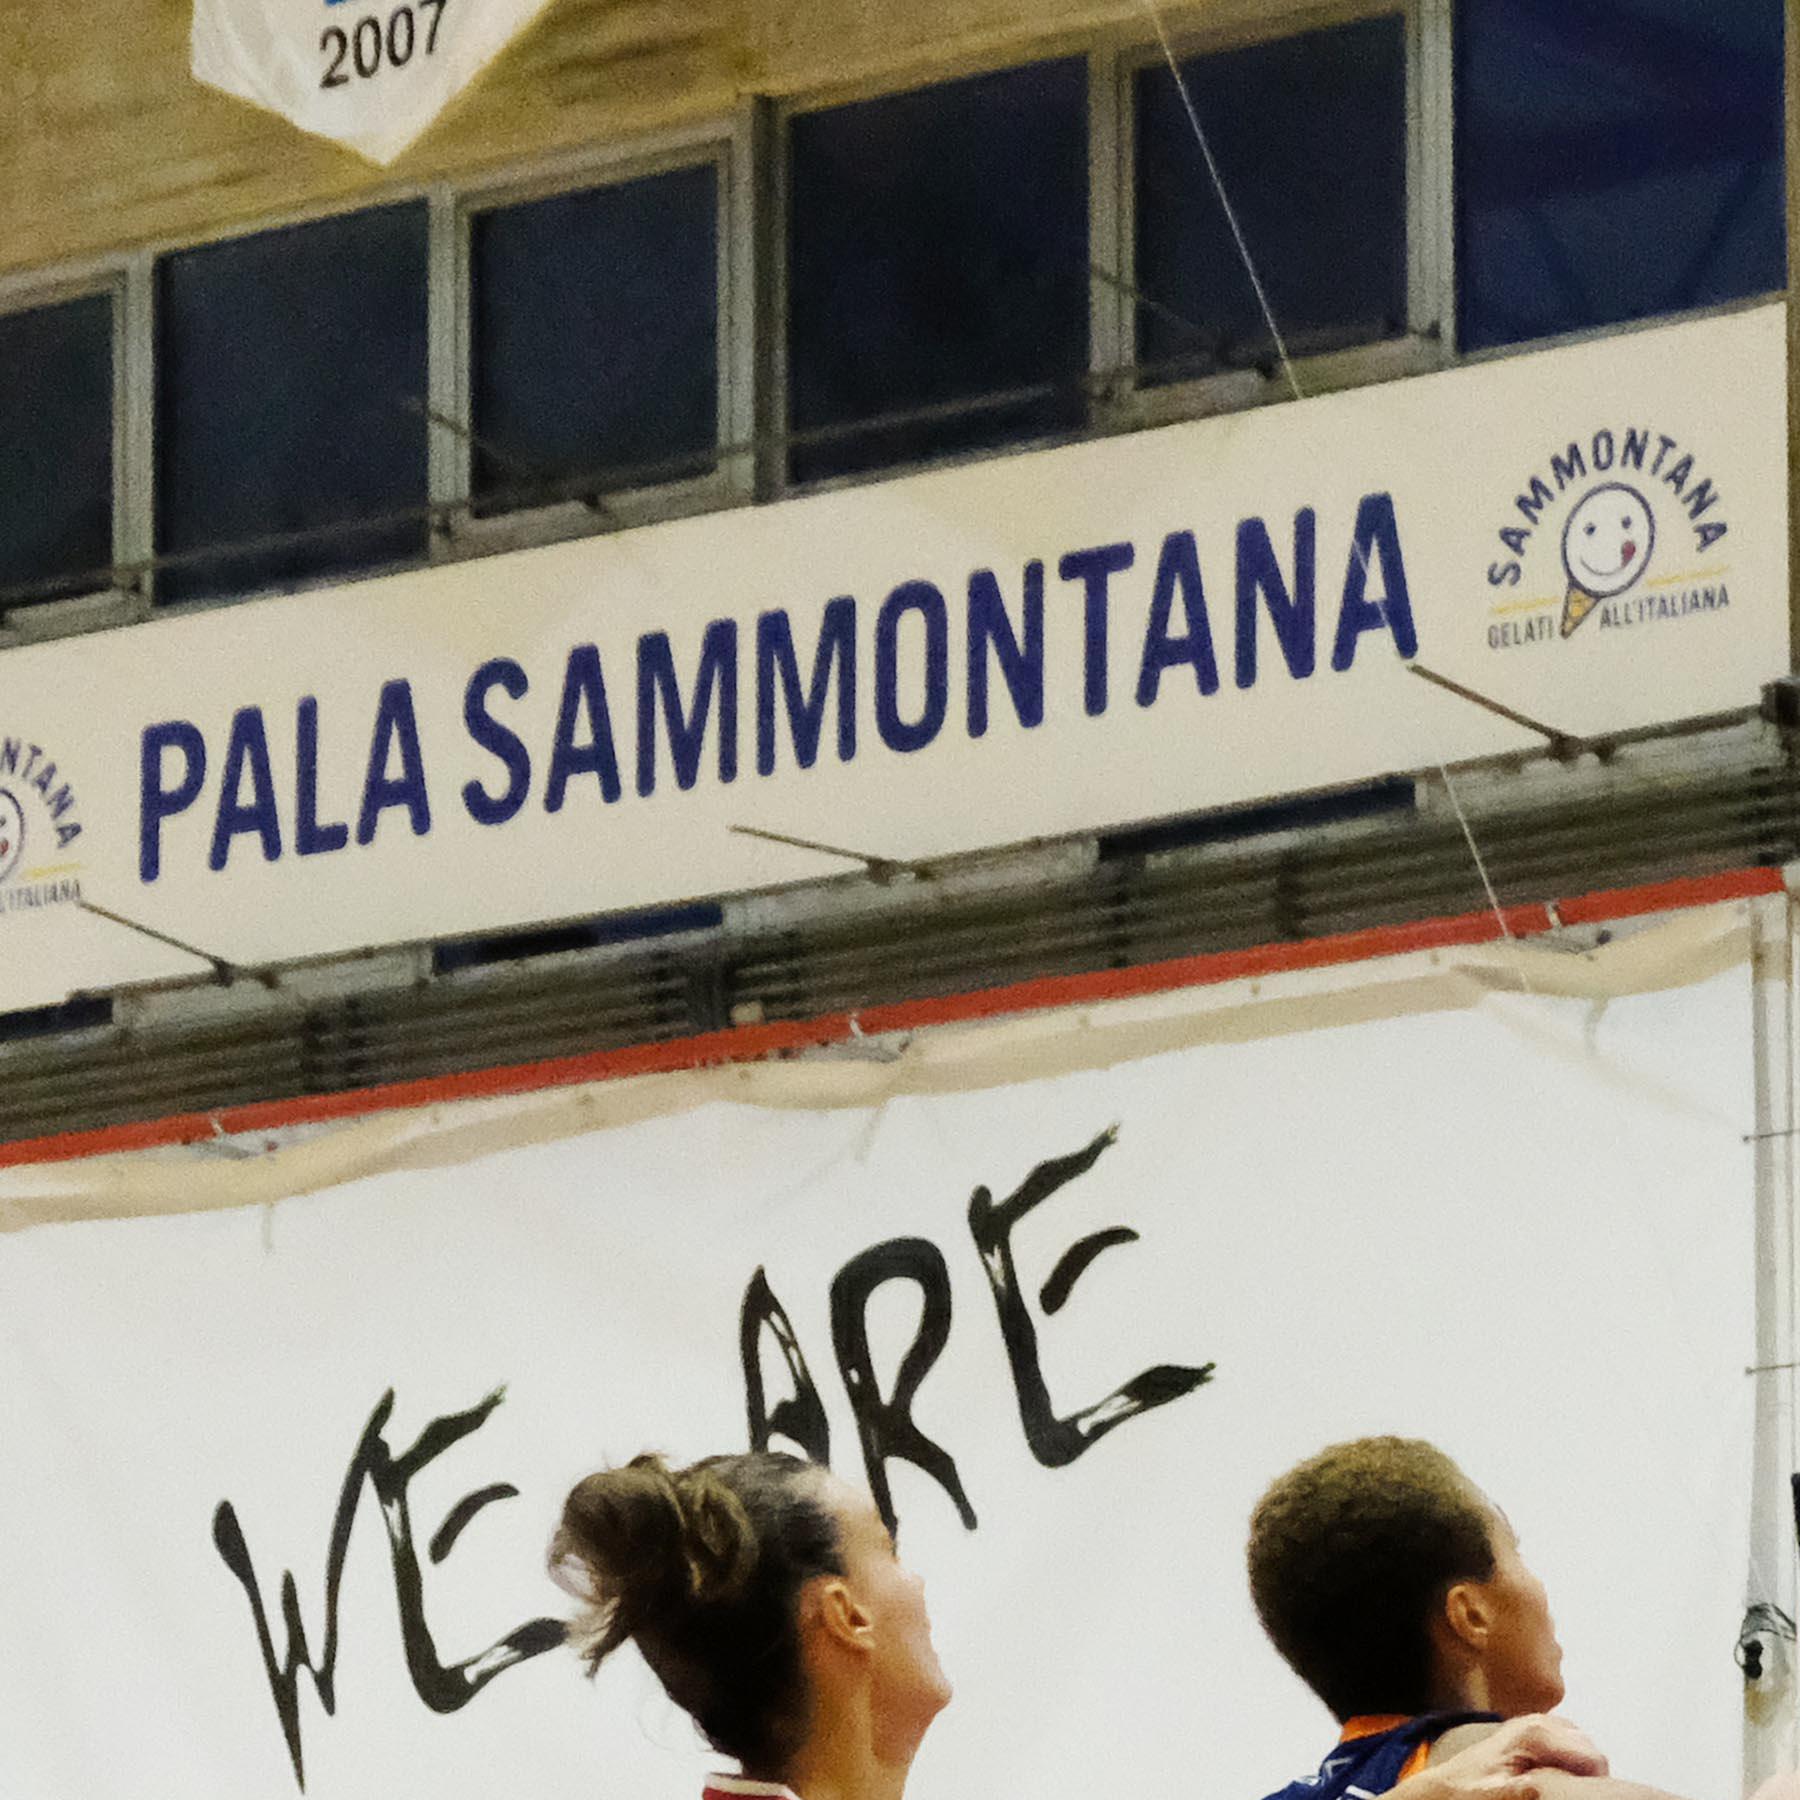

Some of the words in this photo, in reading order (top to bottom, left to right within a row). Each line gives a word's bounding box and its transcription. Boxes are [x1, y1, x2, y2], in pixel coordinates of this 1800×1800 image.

[319, 0, 447, 89] 2007
[1487, 427, 1728, 587] SAMMONTANA
[139, 678, 431, 884] PALA
[461, 492, 1418, 826] SAMMONTANA
[0, 736, 82, 849] NTANA
[212, 1383, 570, 1795] WE
[738, 1123, 1216, 1542] ARE
